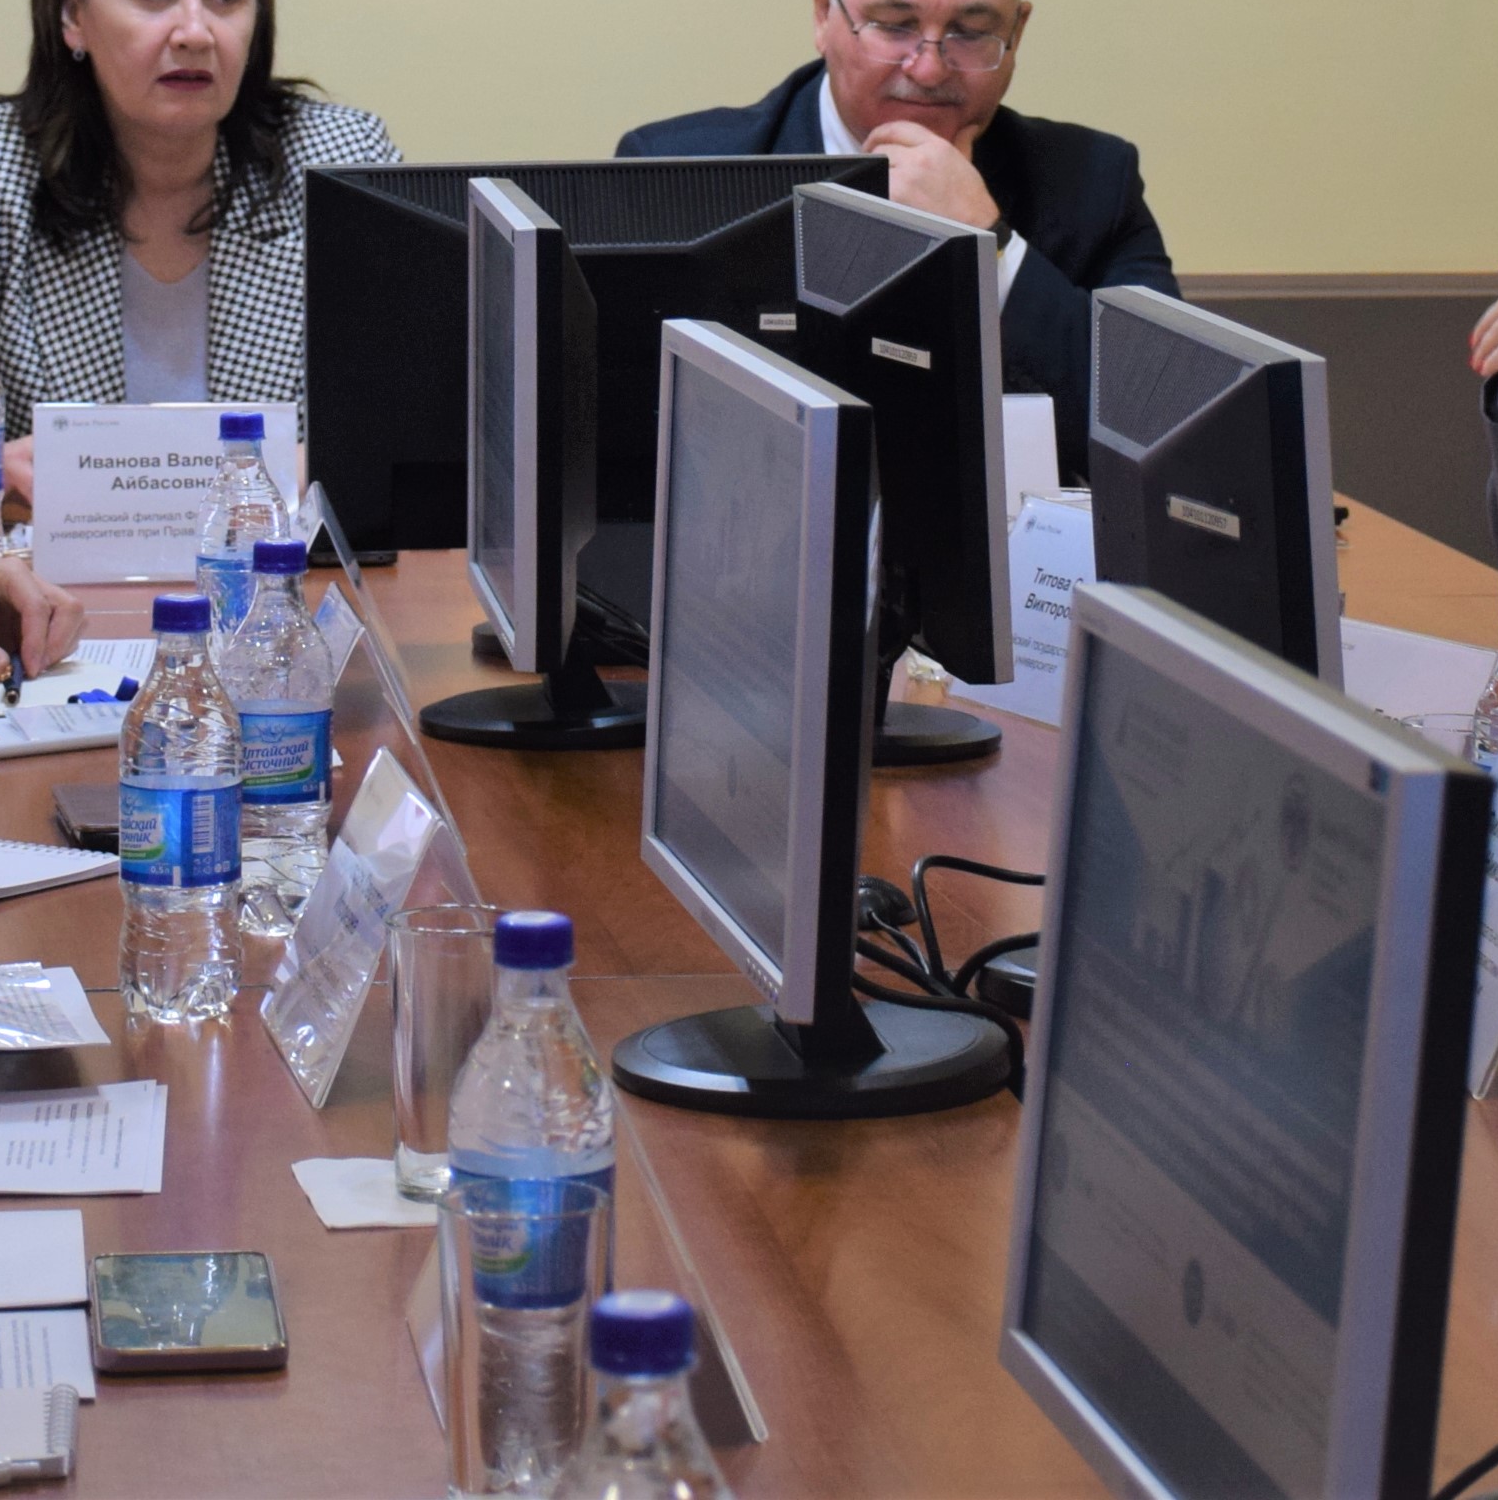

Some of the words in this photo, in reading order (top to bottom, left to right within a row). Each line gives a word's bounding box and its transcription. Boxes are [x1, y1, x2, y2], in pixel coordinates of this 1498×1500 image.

[78, 454, 161, 470] Иванова
[63, 511, 130, 525] Алтайский
[133, 510, 182, 524] филиал
[49, 528, 135, 543] университета
[138, 527, 161, 540] при
[164, 525, 197, 540] Прав
[1033, 567, 1072, 592] Титова
[1024, 592, 1072, 621] Викторо
